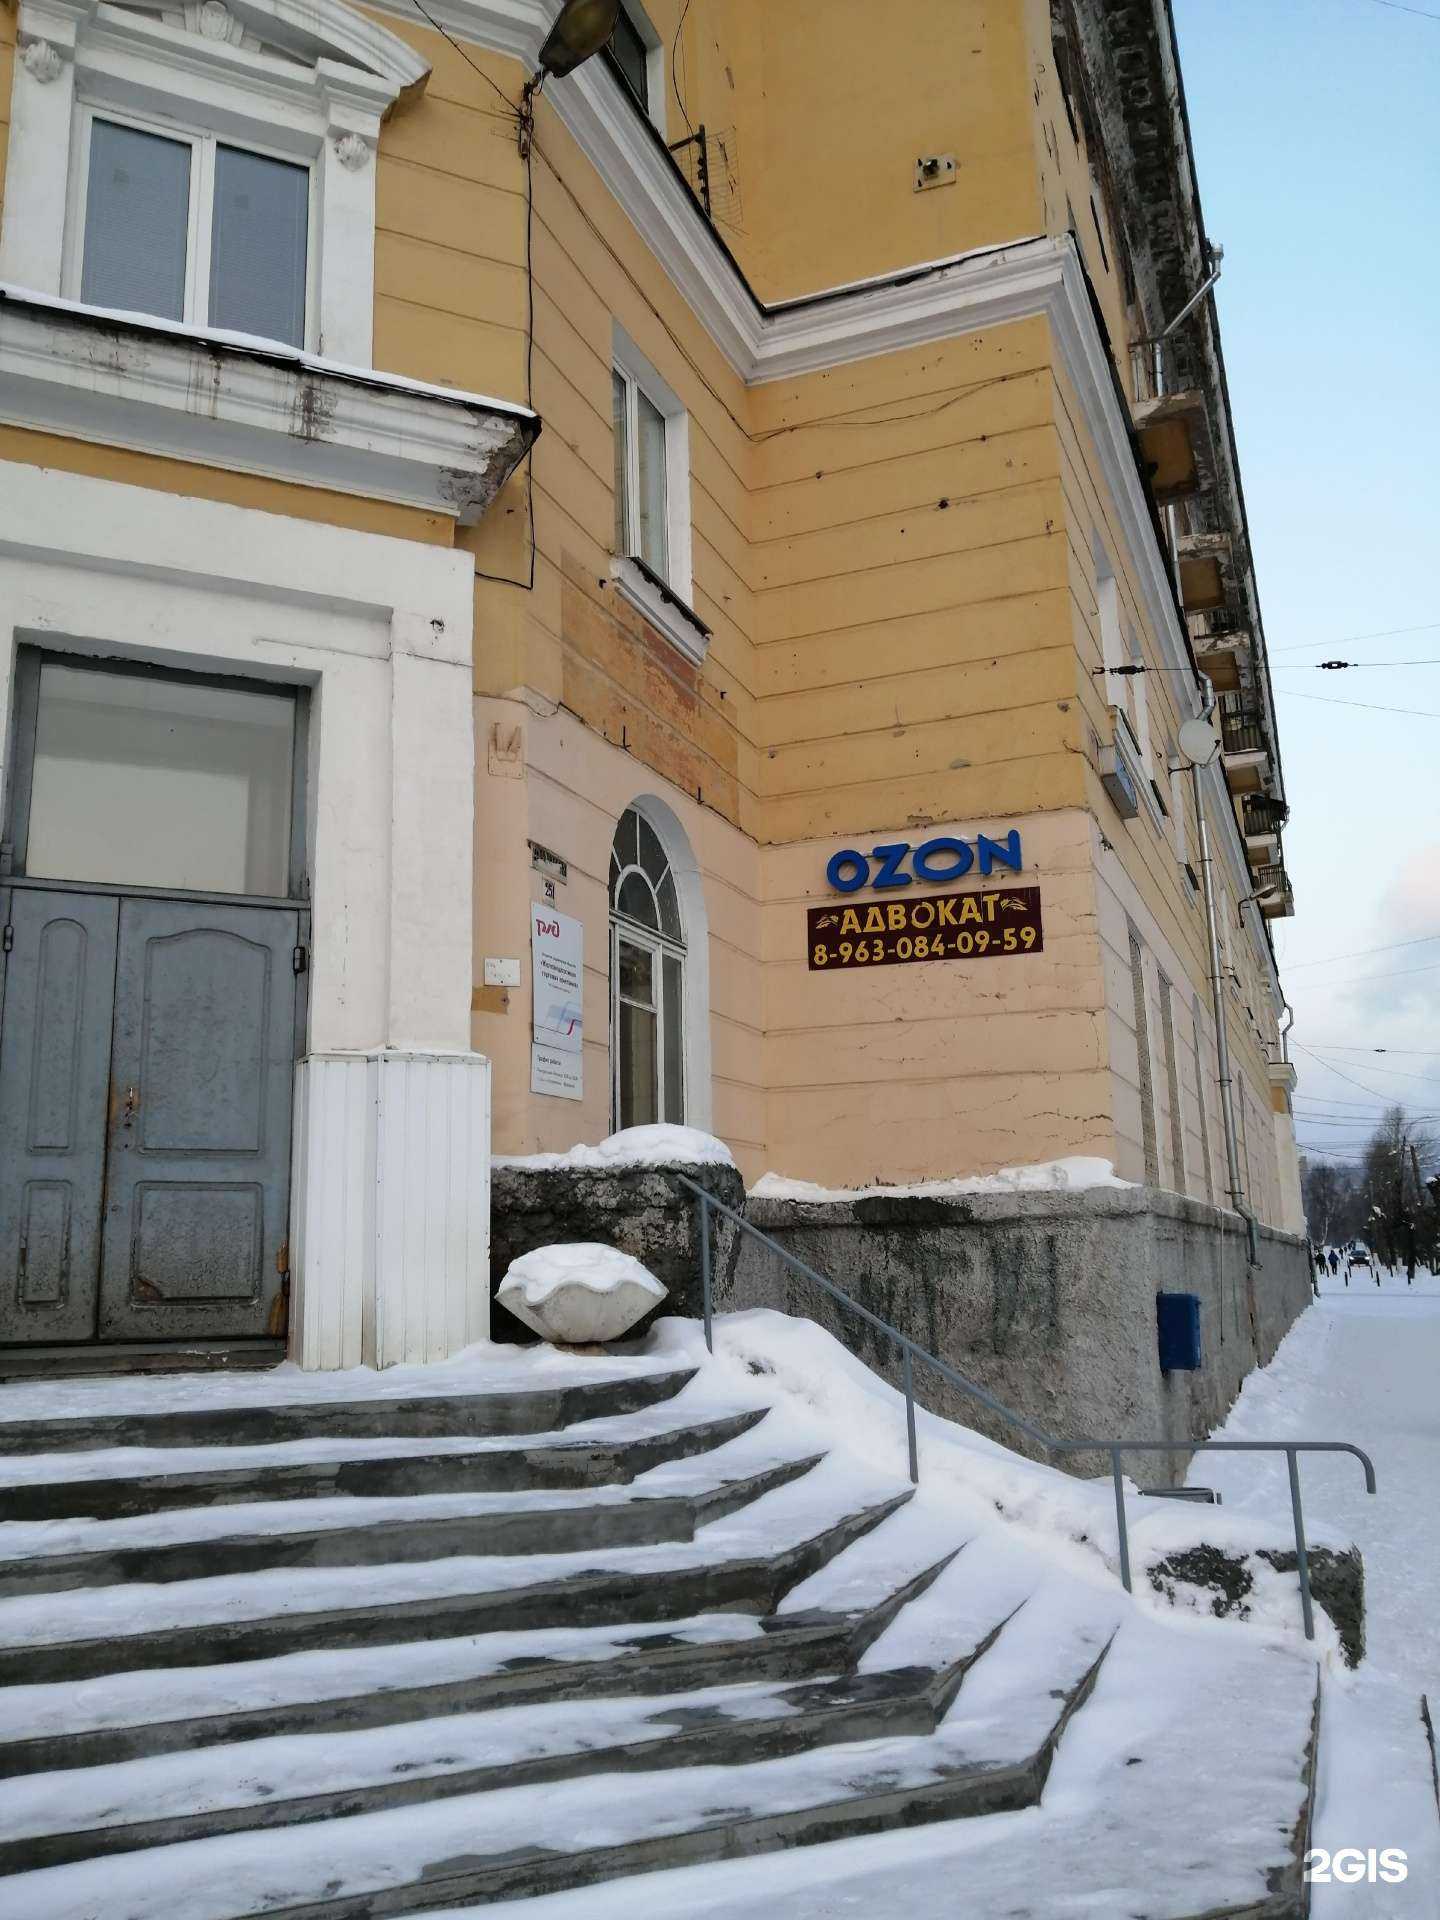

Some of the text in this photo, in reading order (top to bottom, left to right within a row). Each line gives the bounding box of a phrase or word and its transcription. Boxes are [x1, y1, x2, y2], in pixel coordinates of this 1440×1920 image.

[827, 829, 1022, 892] OZON
[840, 894, 1000, 934] АДВОКАТ
[813, 926, 1036, 965] 8-963-084-09-59
